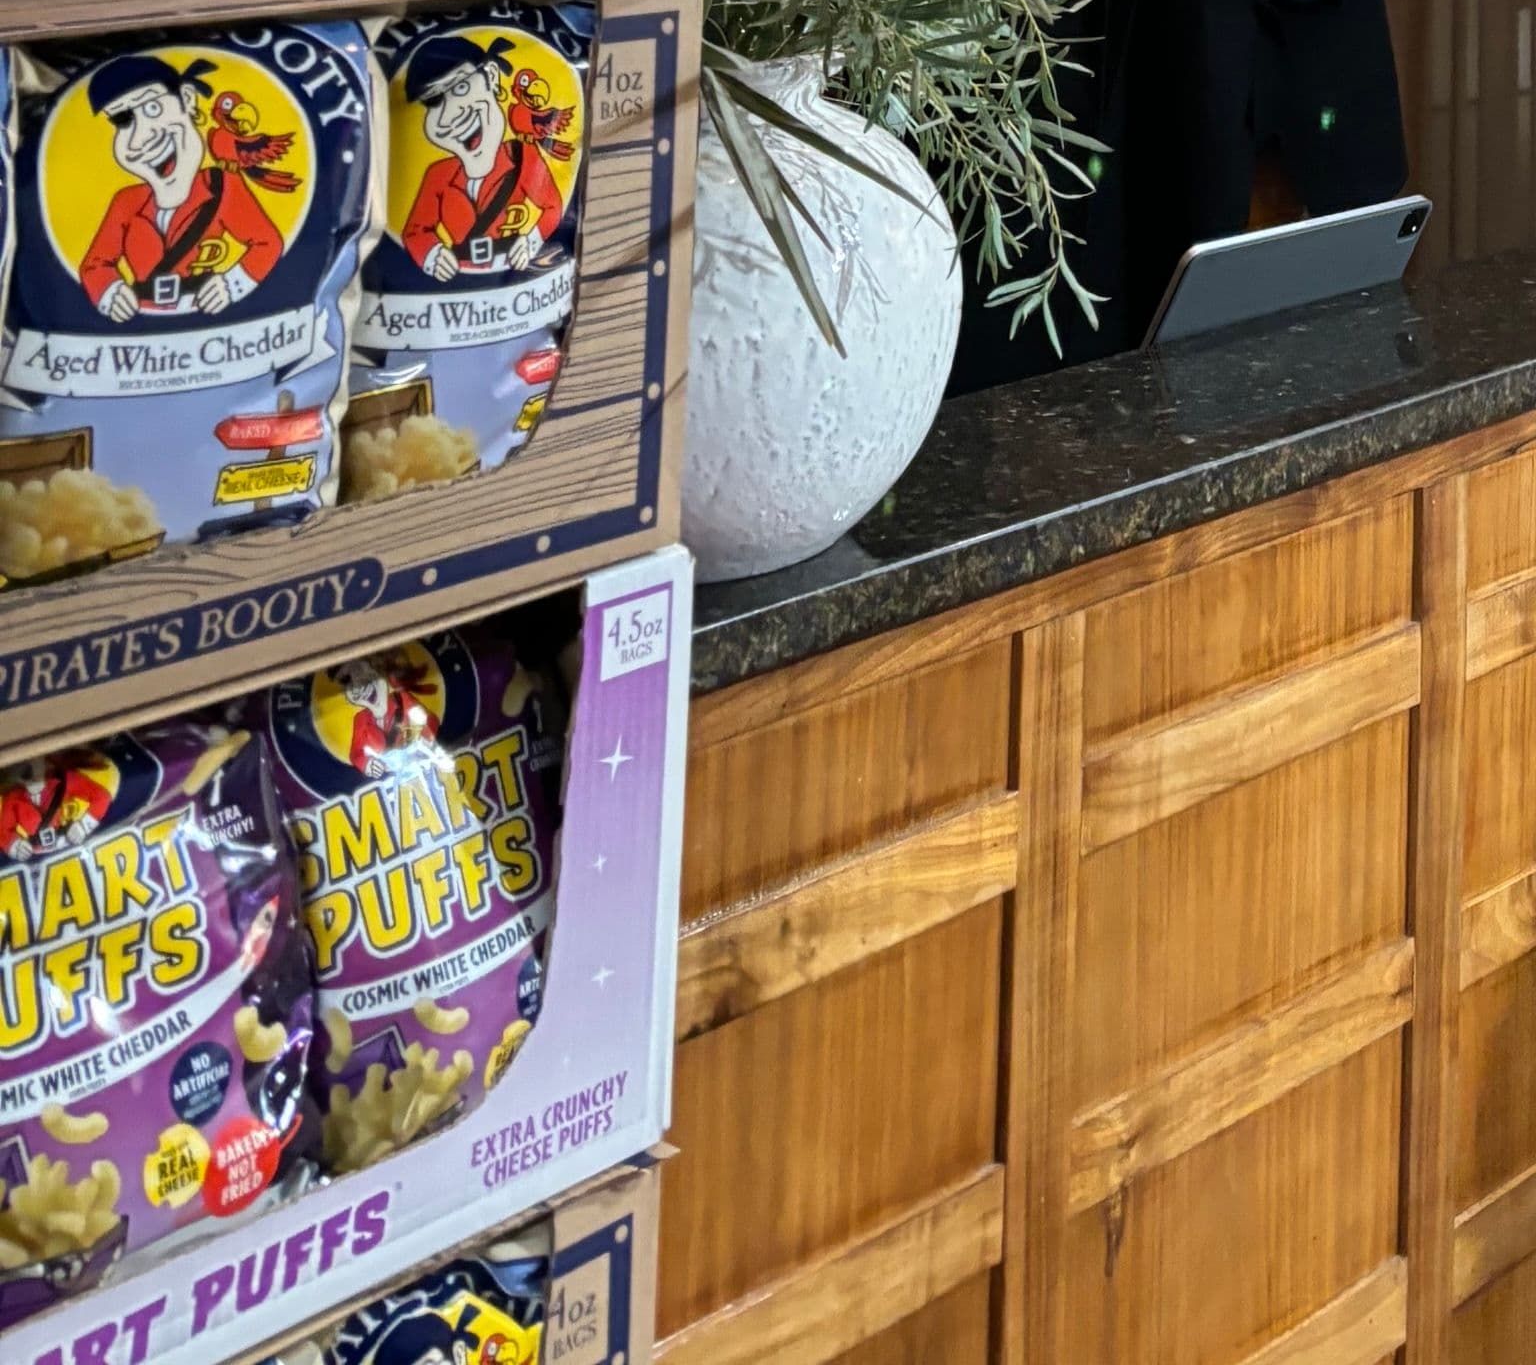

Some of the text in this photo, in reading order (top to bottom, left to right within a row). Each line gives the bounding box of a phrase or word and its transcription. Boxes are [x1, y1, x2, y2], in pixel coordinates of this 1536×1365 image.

[229, 24, 364, 129] OOTY
[600, 97, 644, 121] BAGS
[364, 302, 432, 336] Aged
[439, 300, 508, 328] White
[24, 321, 307, 381] Aged White Cheddar
[196, 569, 356, 650] BOOTY
[608, 610, 662, 647] 4.5oz
[621, 640, 653, 665] BAGS
[202, 805, 242, 830] EXTRA
[303, 816, 538, 972] PUFFS
[342, 916, 536, 1014] COSMIC WHITE CHEDDAR
[41, 1055, 104, 1100] WHITE
[108, 1010, 193, 1067] CHEDDAR
[190, 1053, 210, 1068] NO
[471, 1071, 627, 1167] EXTRA CRUNCHY
[158, 1152, 197, 1178] REAL
[228, 1155, 258, 1182] NOT
[483, 1105, 613, 1189] CHEESE PUFFS
[221, 1171, 263, 1206] FRIED
[191, 1190, 391, 1339] PUFFS
